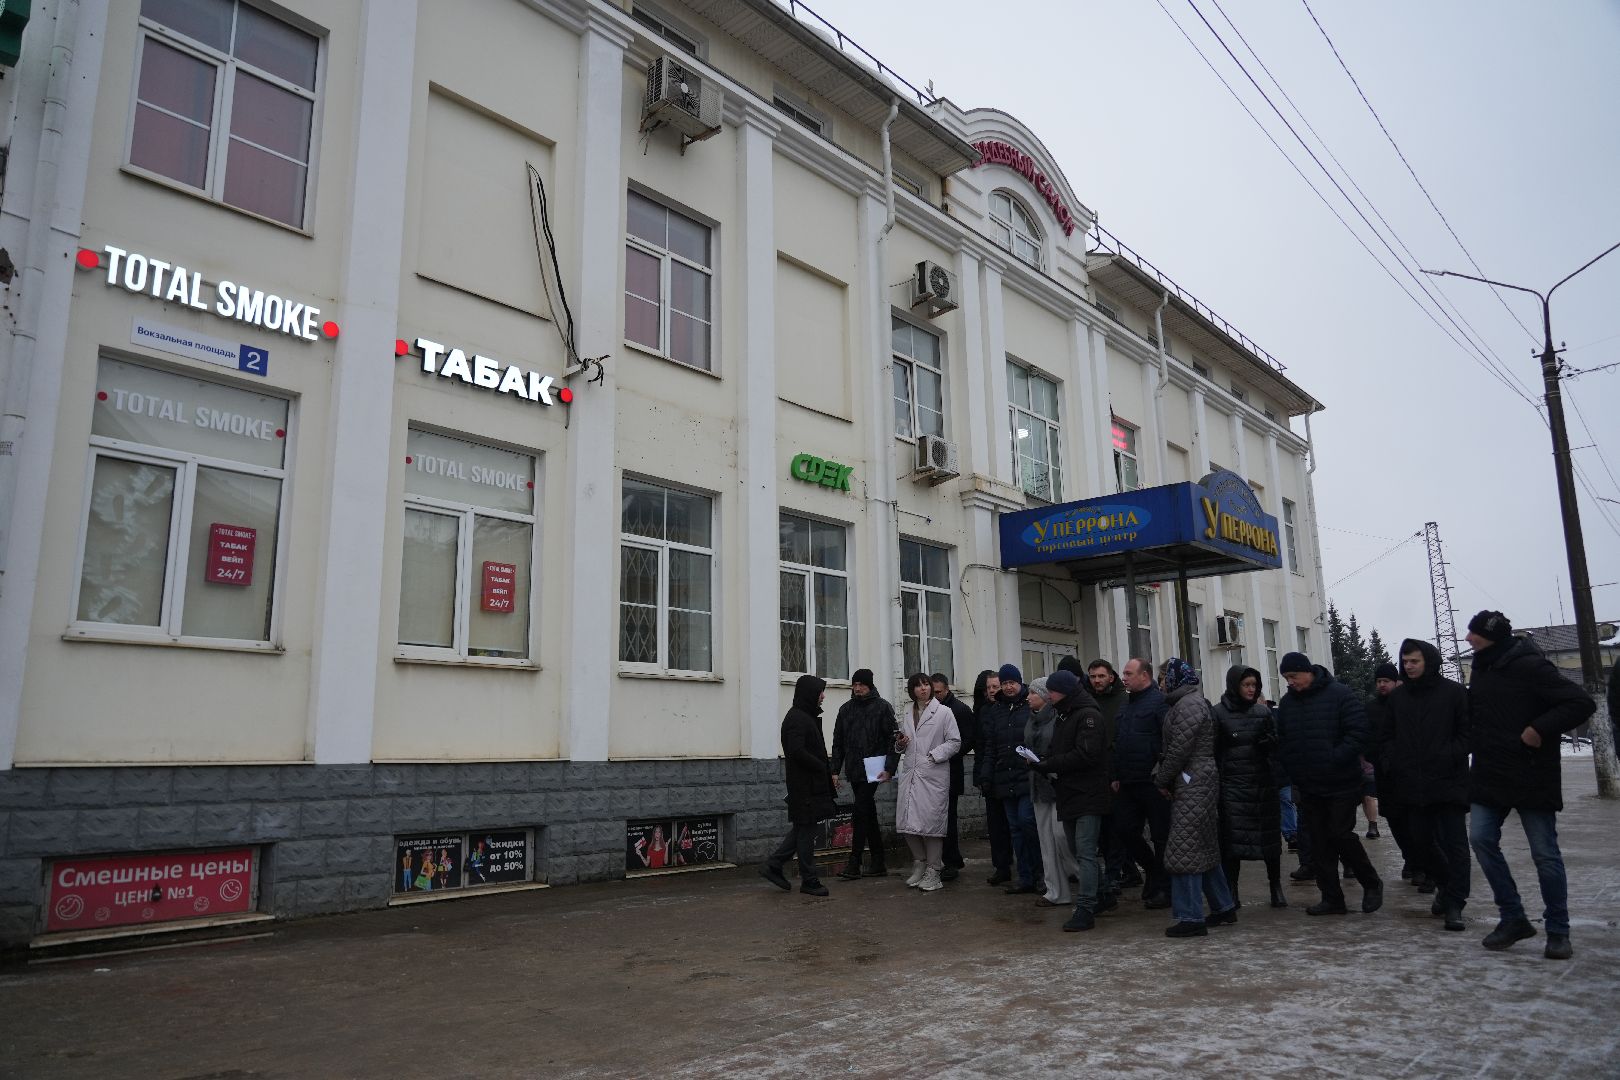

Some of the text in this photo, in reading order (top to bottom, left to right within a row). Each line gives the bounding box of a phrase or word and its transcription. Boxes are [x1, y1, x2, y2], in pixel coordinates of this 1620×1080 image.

[104, 245, 320, 341] TOTAL SMOKE
[137, 326, 261, 371] Вокзальная площадь 2
[415, 338, 554, 406] ТАБАК
[113, 389, 274, 441] TOTAL SMOKE
[415, 453, 525, 492] TOTAL SMOKE
[1033, 520, 1050, 544] У
[1053, 511, 1139, 537] ПЕРРОНА
[1202, 497, 1218, 538] У
[1220, 512, 1278, 556] ПЕРРОНА
[220, 541, 248, 551] ТАБАК
[1036, 531, 1138, 553] торговый центр
[221, 555, 244, 564] ВЕЙП
[217, 568, 245, 580] 24/7
[490, 576, 510, 584] ТАБАК
[490, 598, 510, 608] 24/7
[440, 837, 461, 845] обувь
[490, 841, 525, 849] скидки
[504, 850, 523, 859] 10%
[59, 859, 249, 888] Смешные цены
[490, 861, 523, 872] до 50%
[167, 885, 194, 900] №1
